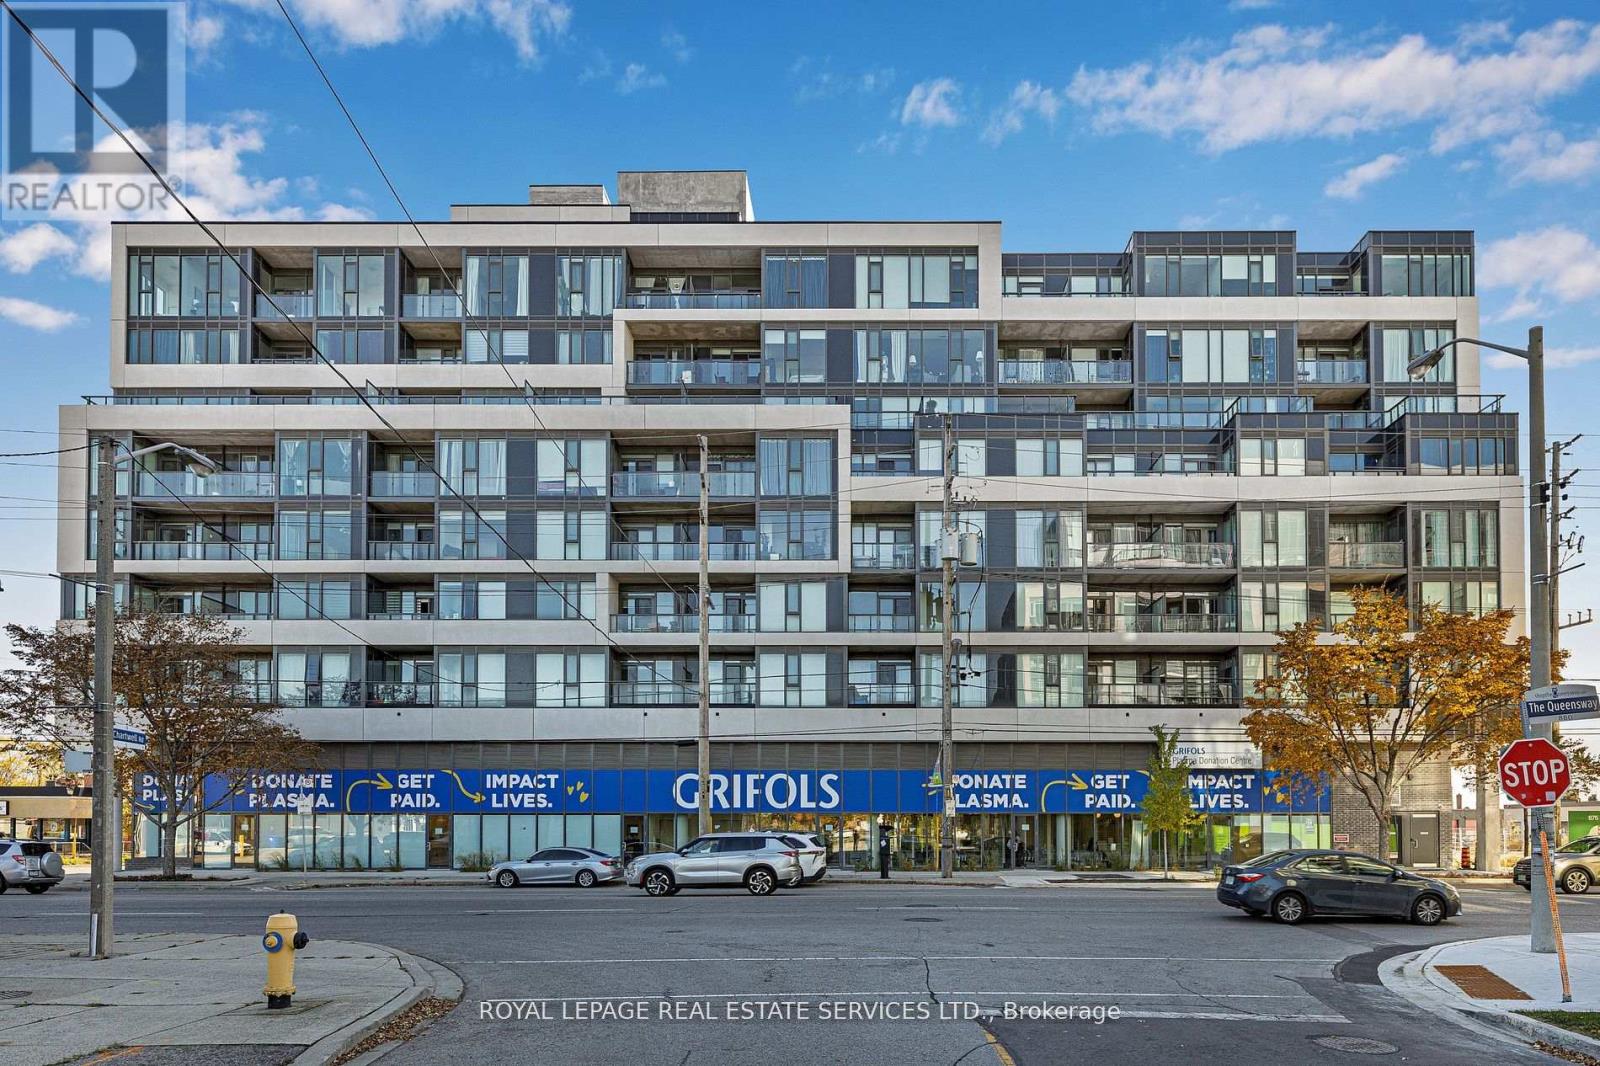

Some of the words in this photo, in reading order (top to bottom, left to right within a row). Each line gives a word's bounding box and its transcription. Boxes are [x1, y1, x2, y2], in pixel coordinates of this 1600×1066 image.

[1528, 702, 1545, 713] The
[1547, 699, 1598, 712] Queensway
[1172, 747, 1206, 755] GRIFOLS
[1200, 756, 1229, 765] Donation
[1230, 756, 1252, 765] Centre
[1504, 759, 1565, 788] STOP
[398, 774, 435, 789] GET
[486, 774, 559, 789] IMPACT
[954, 774, 1027, 789] ONATE
[1091, 774, 1130, 789] GET
[1184, 774, 1255, 789] MPACT
[673, 773, 840, 809] GRIFOLS
[390, 793, 441, 808] PAID.
[491, 793, 553, 808] LIVES.
[955, 793, 1029, 808] LASMA.
[1085, 793, 1136, 808] PAID.
[1189, 793, 1249, 808] LIVES.
